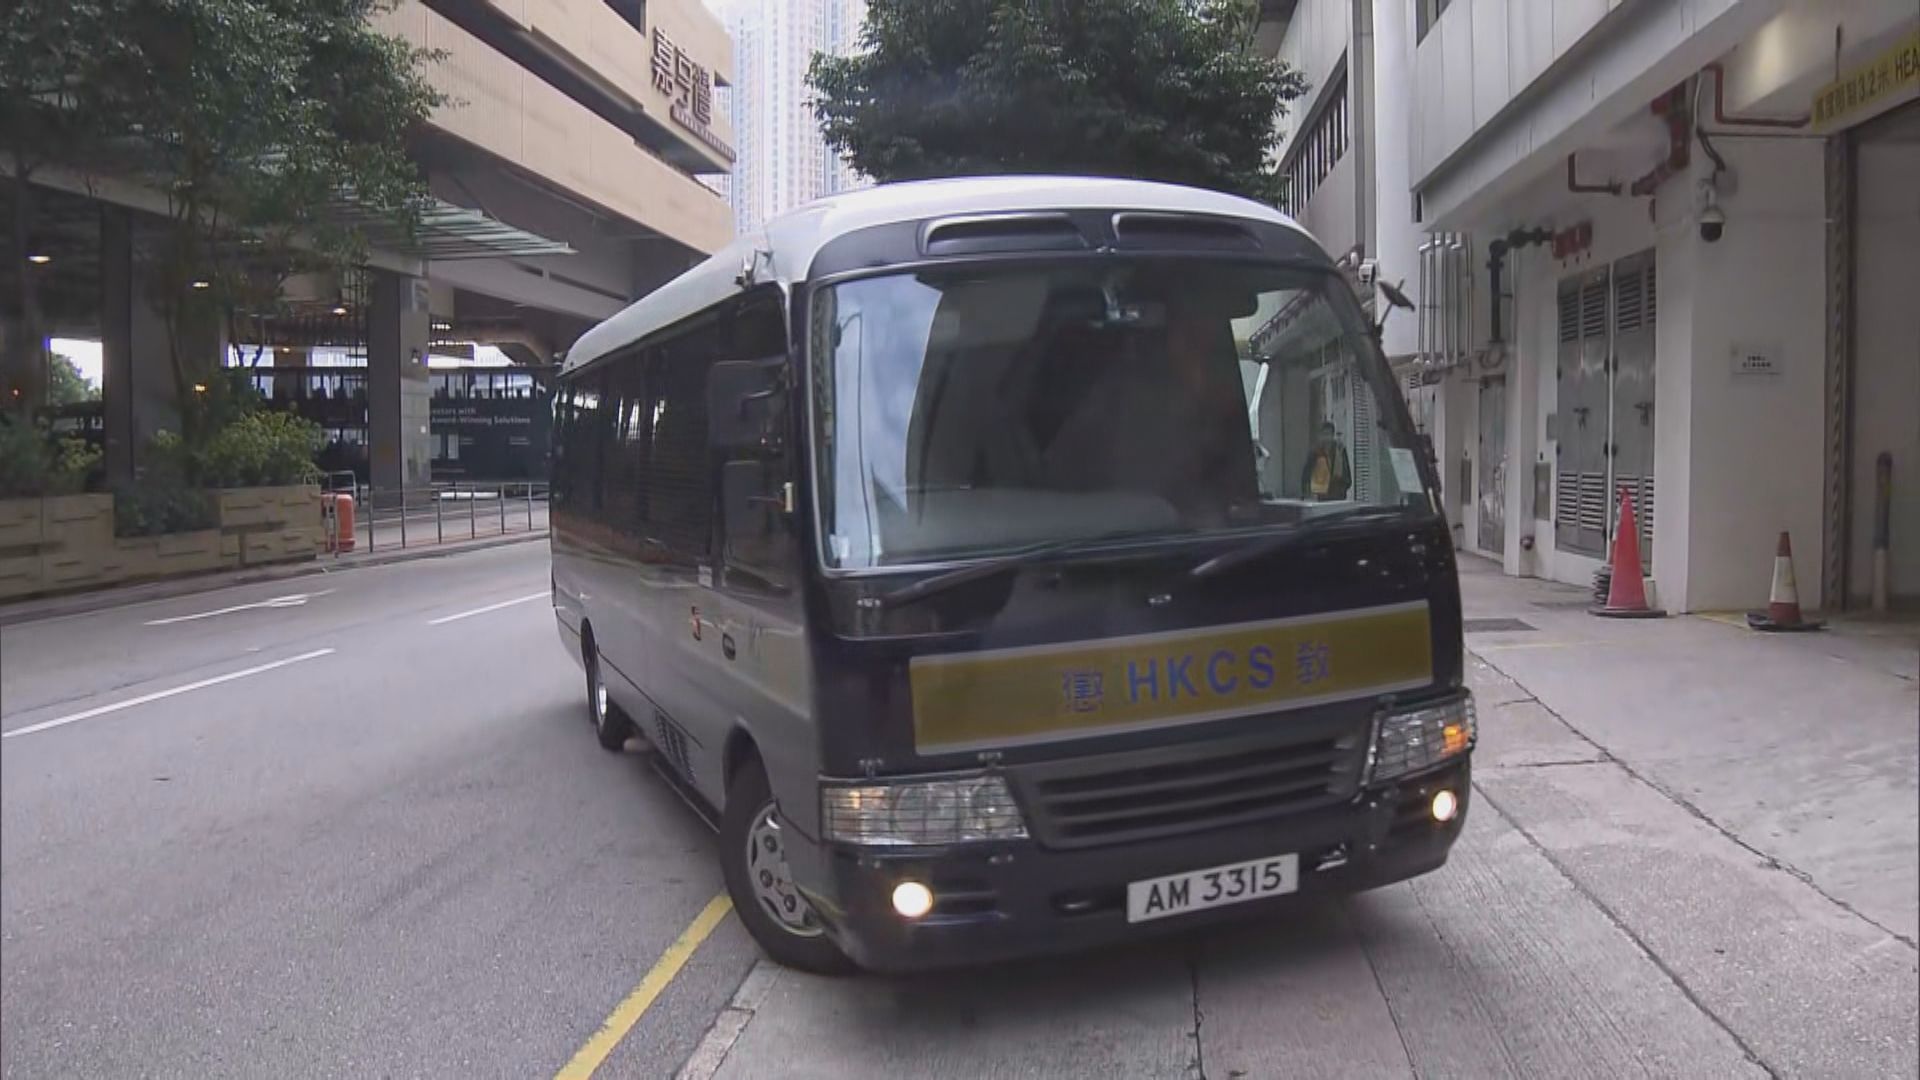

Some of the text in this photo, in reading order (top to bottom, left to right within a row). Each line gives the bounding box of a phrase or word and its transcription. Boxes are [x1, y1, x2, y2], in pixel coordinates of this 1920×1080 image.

[1127, 643, 1275, 704] HKCS
[1145, 862, 1282, 914] AM 3315
